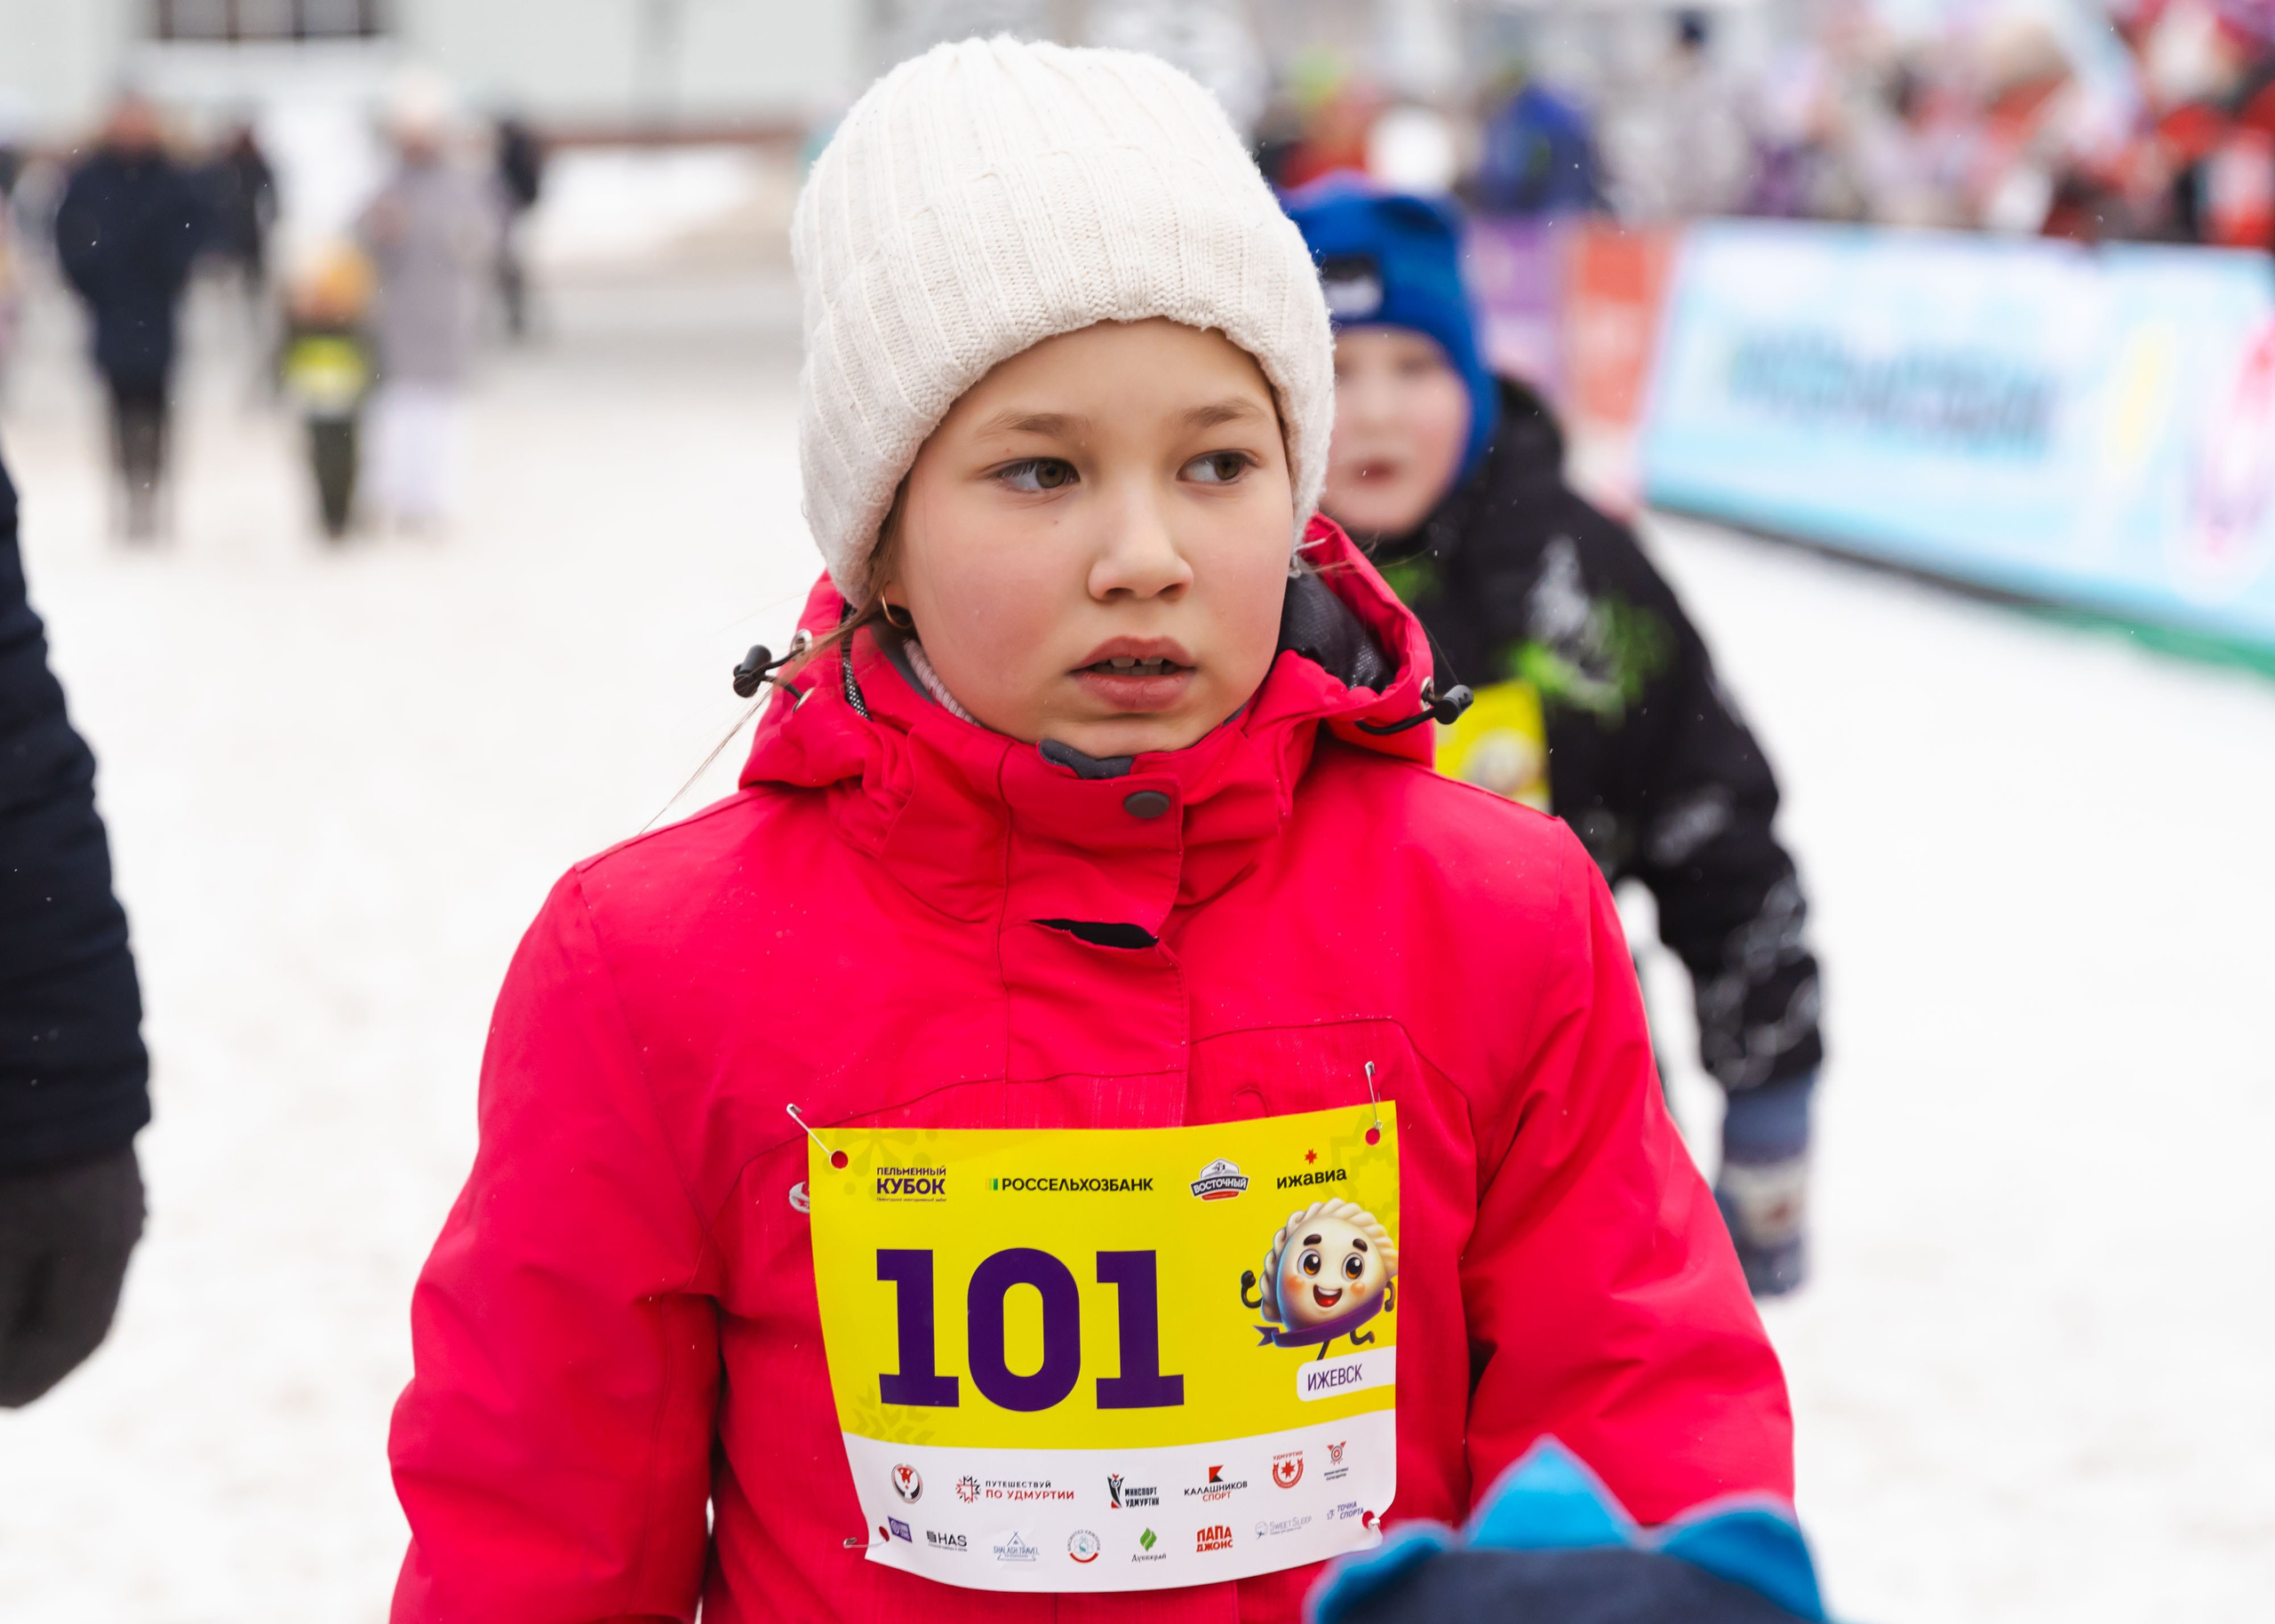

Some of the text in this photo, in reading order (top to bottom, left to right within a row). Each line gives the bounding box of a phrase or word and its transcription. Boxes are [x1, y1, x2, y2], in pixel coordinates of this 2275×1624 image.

[876, 1166, 946, 1176] ПЕЛЬМЕННЫЙ
[1002, 1178, 1154, 1191] РОССЕЛЬХОЗБАНК
[1193, 1177, 1247, 1194] ВОСТОЧНЫЙ
[1276, 1168, 1347, 1190] ижавиа
[876, 1178, 946, 1195] КУБОК
[876, 1247, 1185, 1413] 101
[1307, 1364, 1362, 1391] ИЖЕВСК
[986, 1480, 1052, 1489] ПУТЕШЕСТВУЙ
[1184, 1481, 1248, 1496] КАЛАШНИКОВ
[986, 1489, 1074, 1501] ПО УДМУРТИИ
[1124, 1486, 1158, 1497] МИНСПОРТ
[1202, 1492, 1232, 1502] СПОРТ
[1125, 1497, 1160, 1509] УДМУРТИИ
[1337, 1501, 1357, 1513] ТОЧКА
[1339, 1508, 1364, 1520] СПОРТА
[1196, 1524, 1233, 1542] ПАПА
[938, 1532, 967, 1548] HAS
[1196, 1540, 1233, 1553] ДЖОНС
